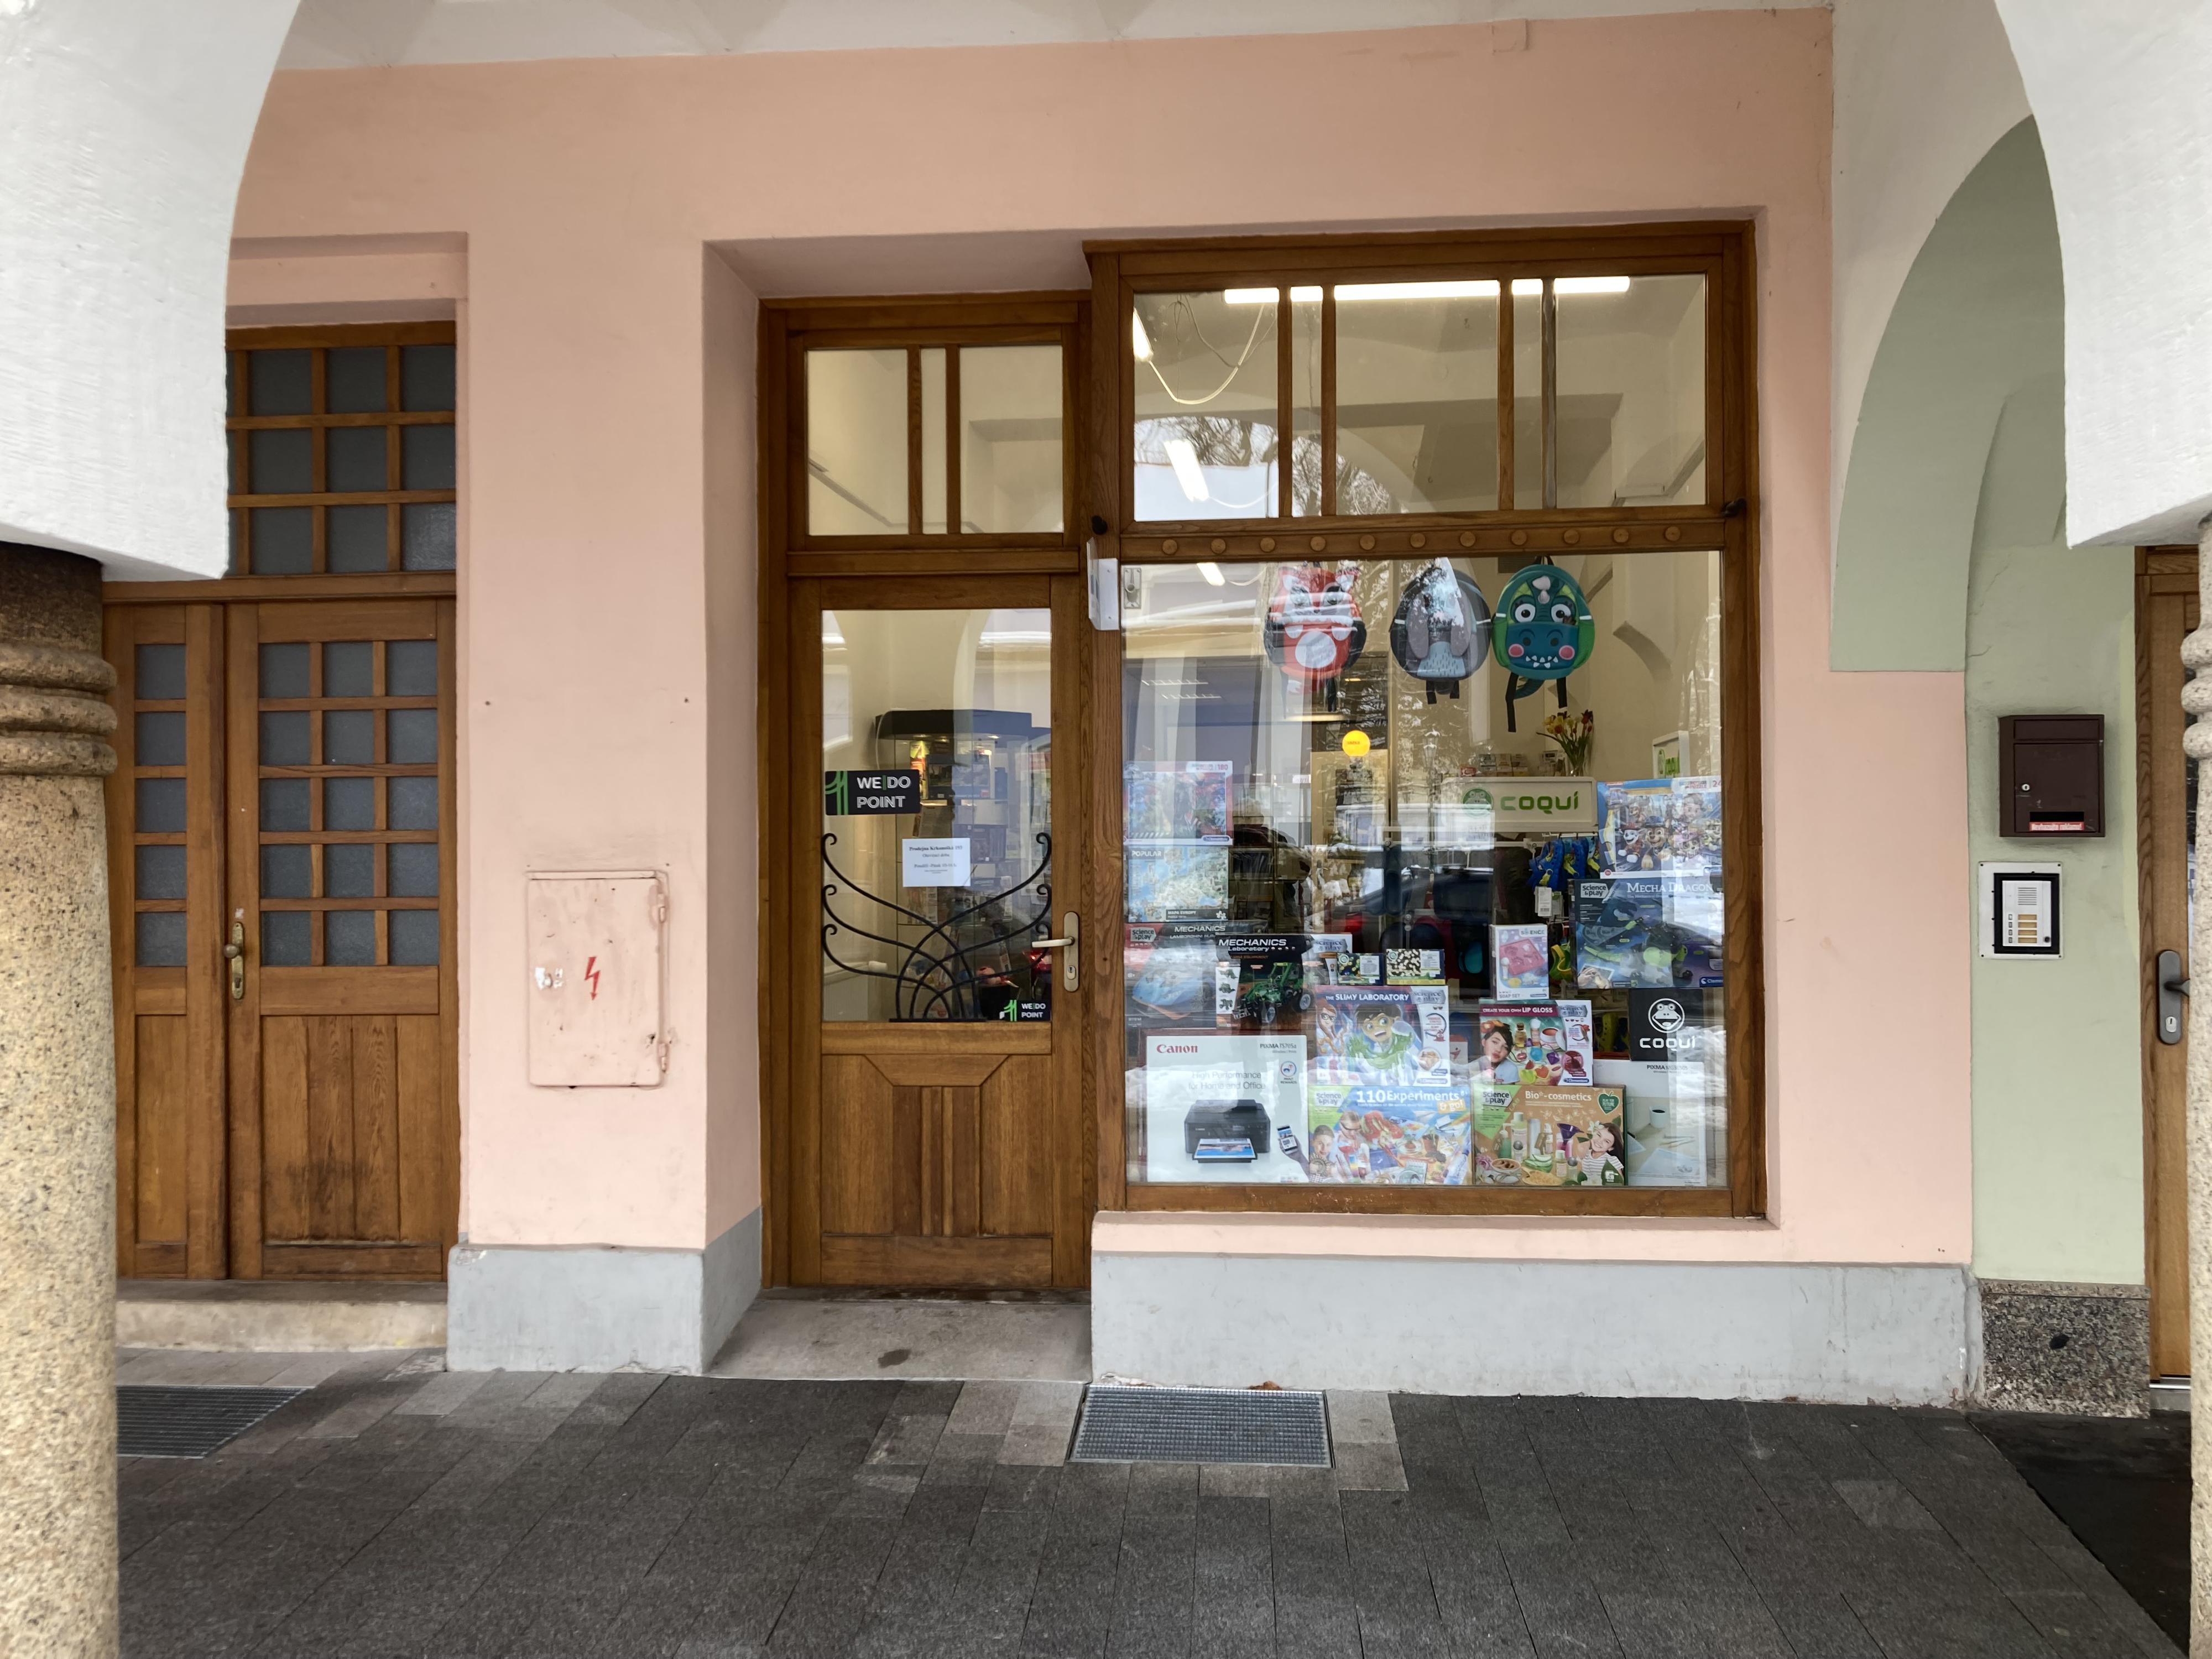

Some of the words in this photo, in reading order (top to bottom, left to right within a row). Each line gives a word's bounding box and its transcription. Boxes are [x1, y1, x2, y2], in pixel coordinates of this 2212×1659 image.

[857, 795, 906, 808] POINT
[1156, 1044, 1198, 1053] Canon
[1243, 1081, 1266, 1089] Office
[1357, 1089, 1386, 1103] 110
[1387, 1091, 1459, 1103] Experiments
